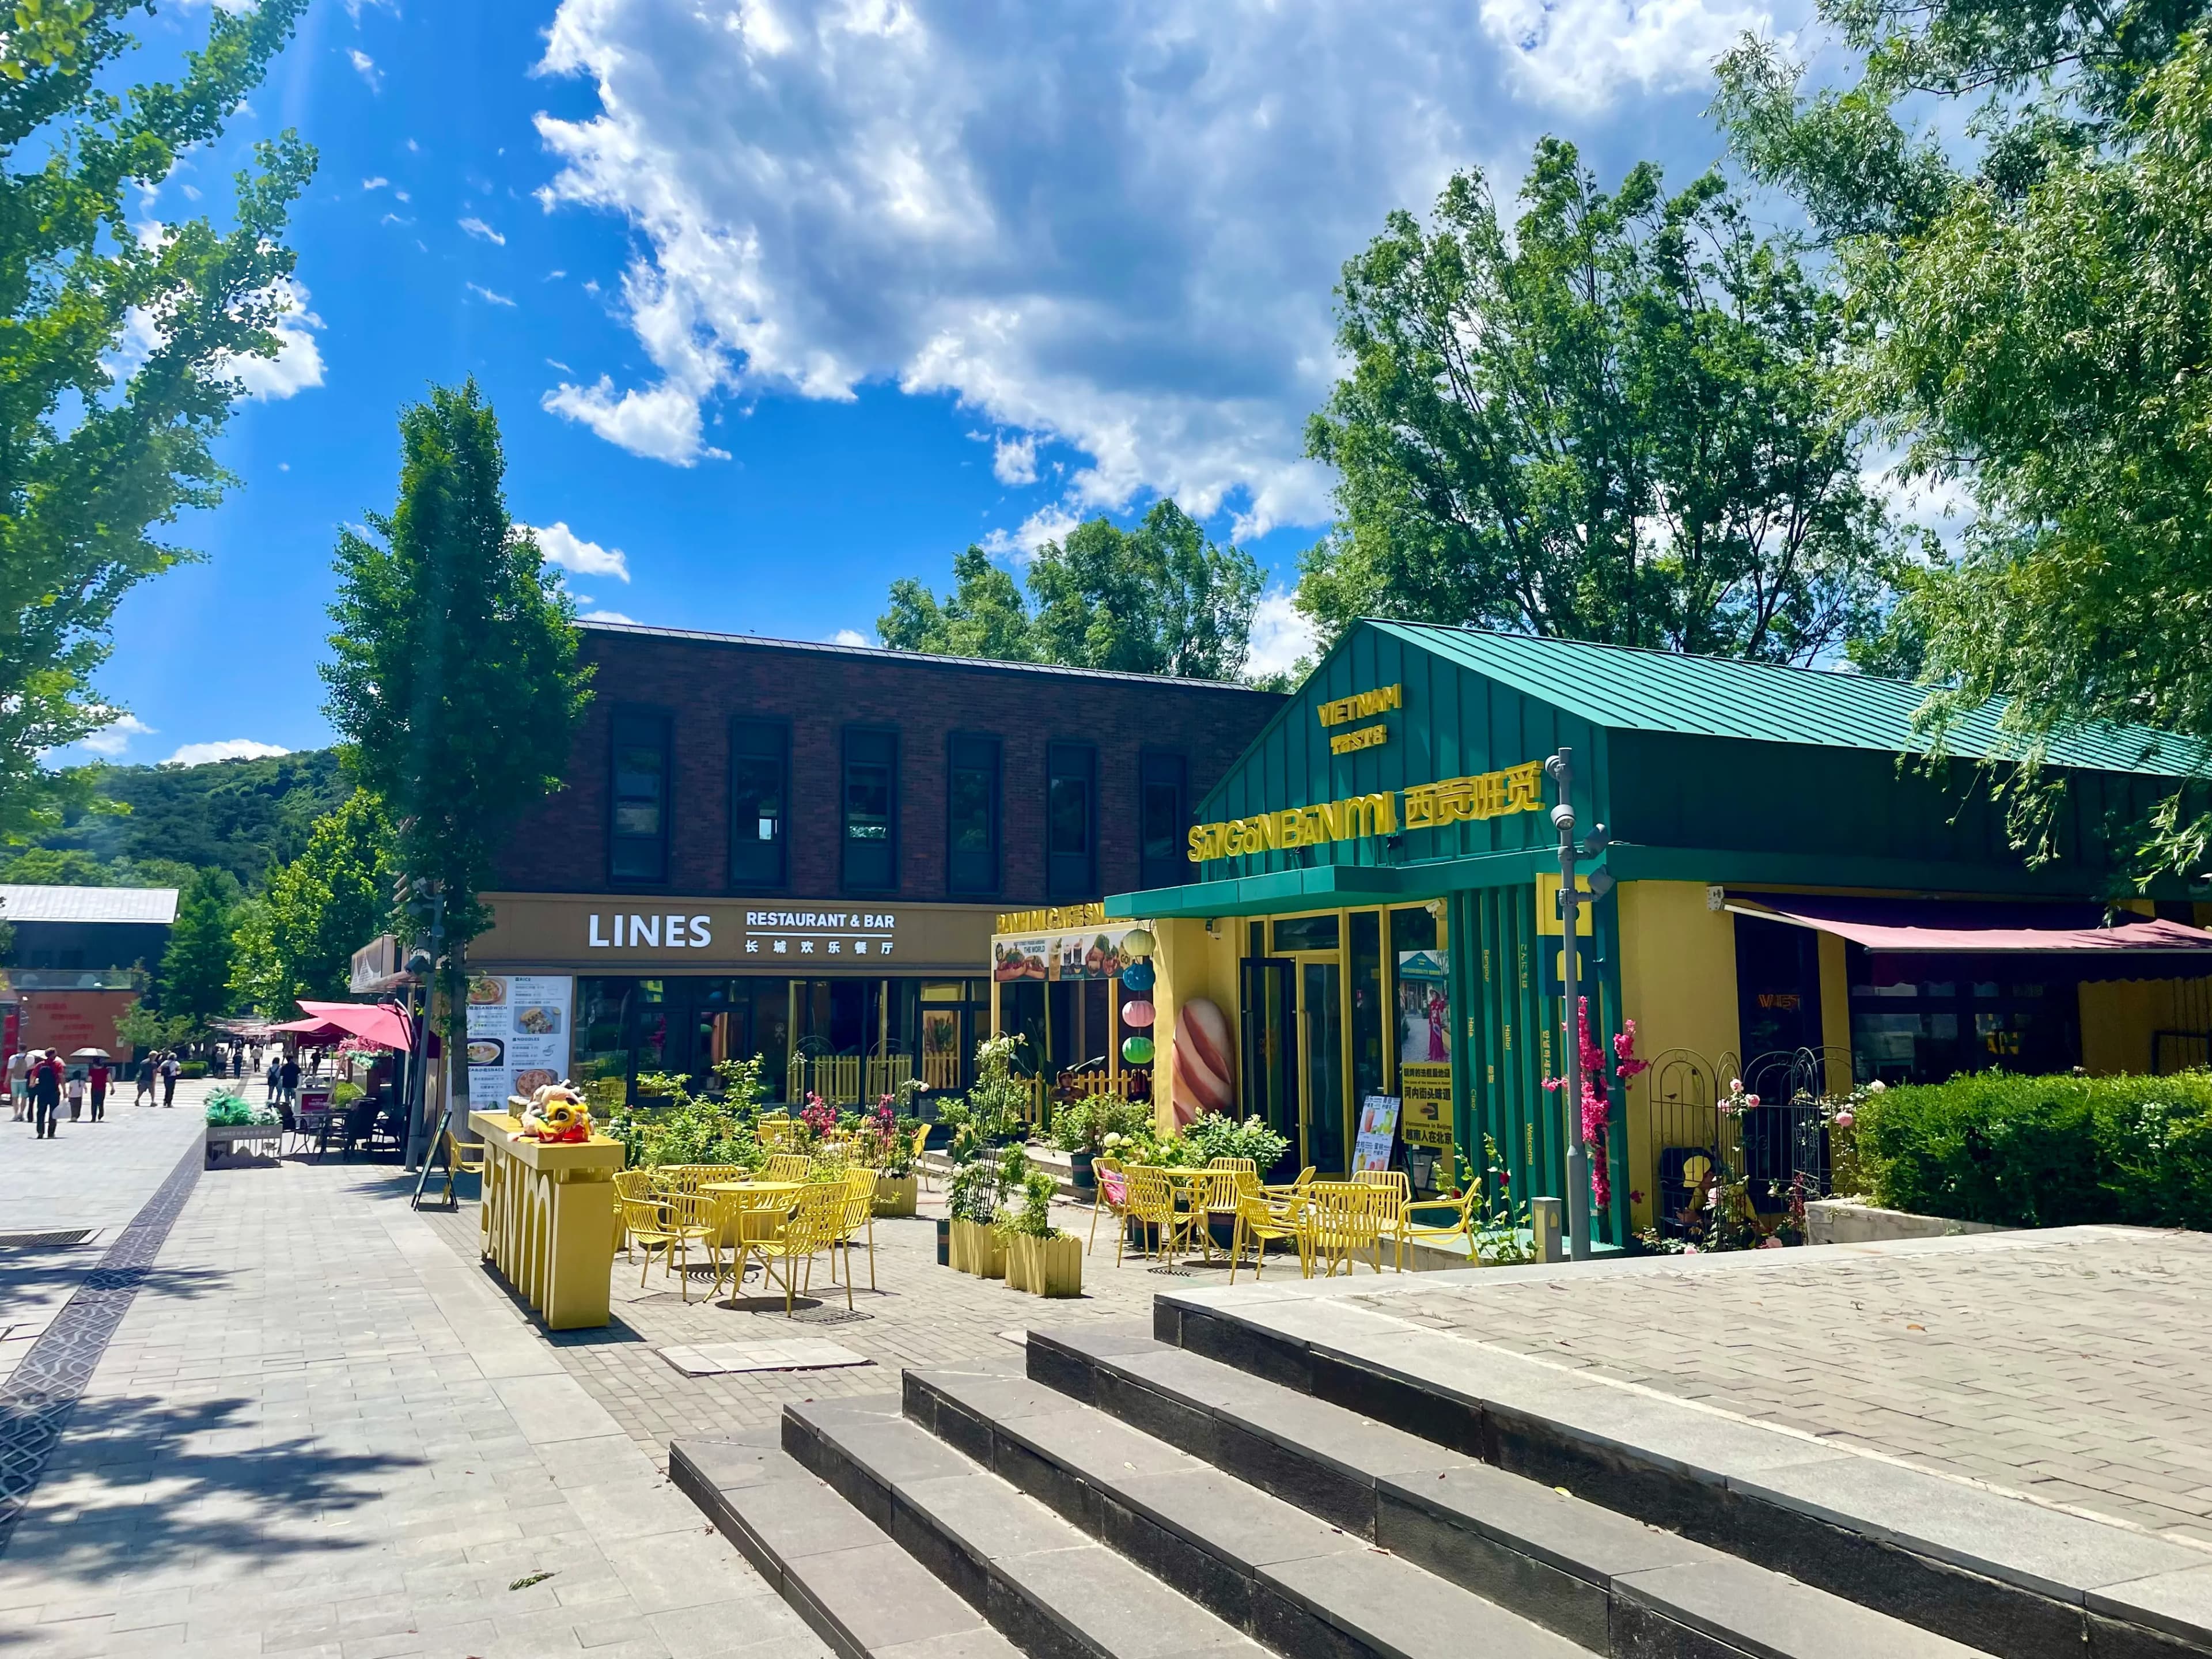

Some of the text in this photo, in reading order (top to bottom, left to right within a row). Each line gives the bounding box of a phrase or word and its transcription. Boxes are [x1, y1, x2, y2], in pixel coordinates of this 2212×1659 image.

[1317, 683, 1402, 727] VIETNAM
[588, 914, 711, 948] LINES
[746, 912, 895, 928] RESTAURANT & BAR
